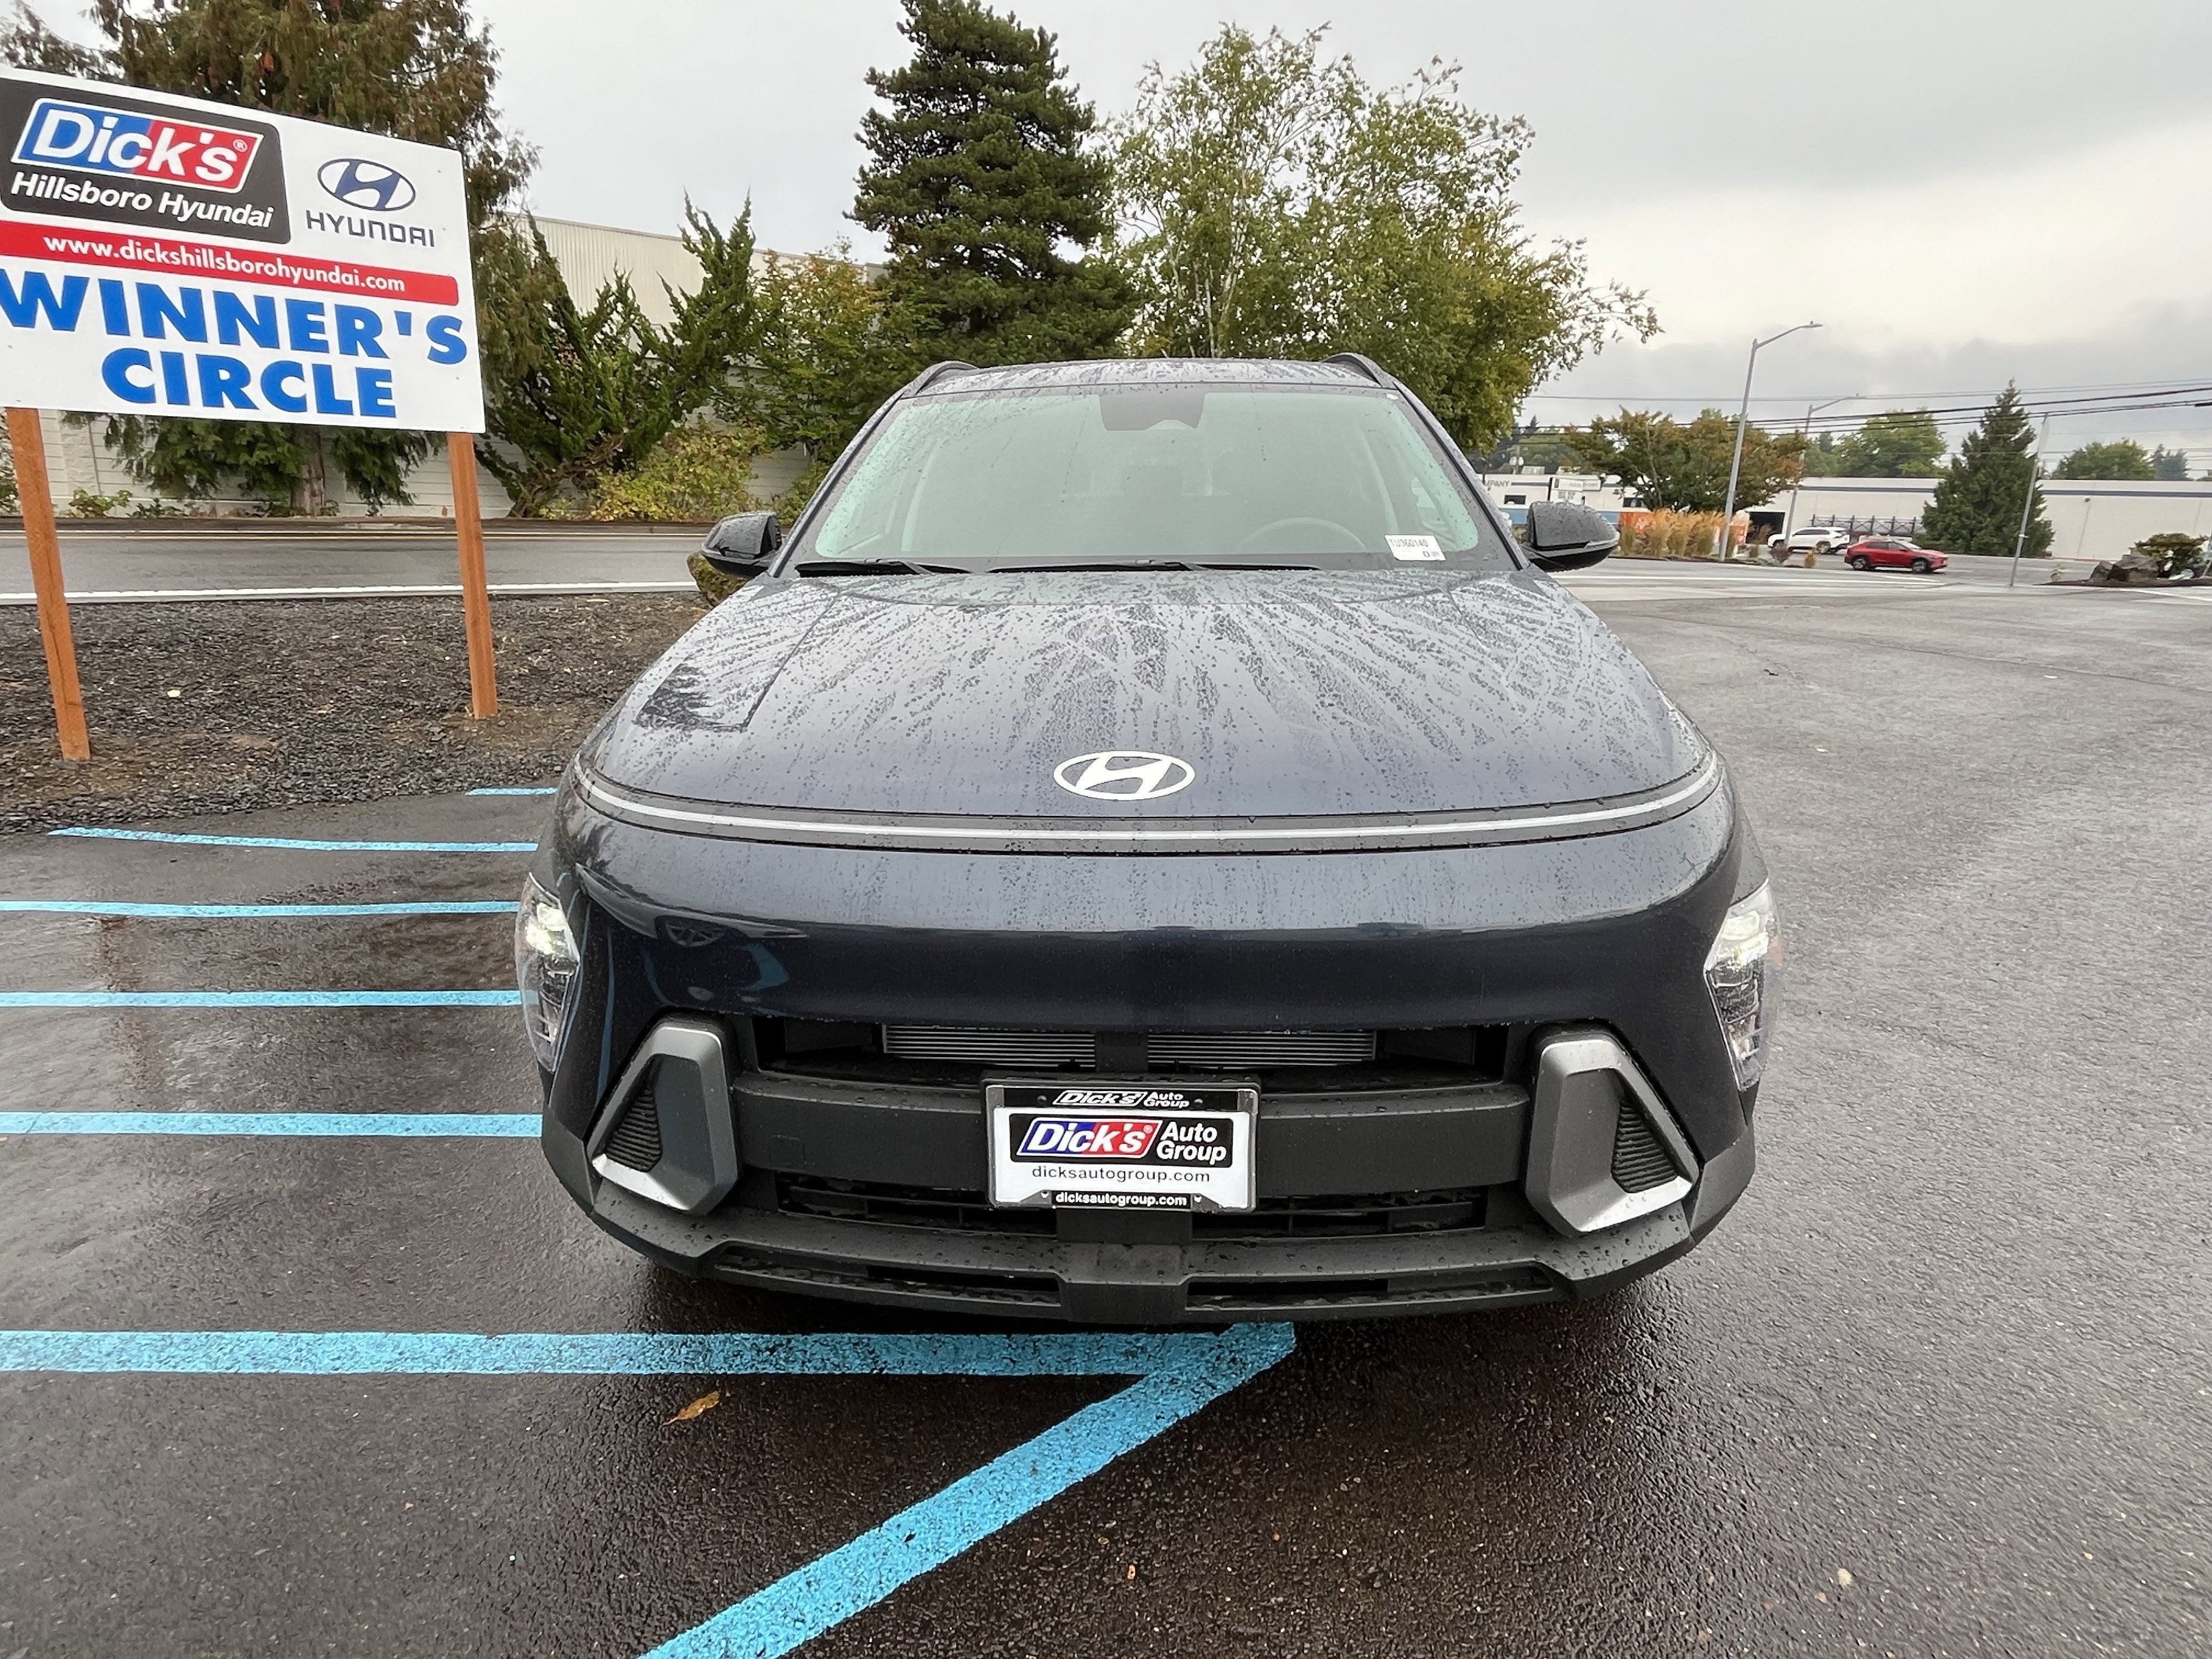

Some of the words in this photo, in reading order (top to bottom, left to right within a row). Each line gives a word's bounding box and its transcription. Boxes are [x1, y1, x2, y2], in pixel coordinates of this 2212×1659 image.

[11, 172, 153, 211] Hillsboro
[157, 191, 274, 228] Hyundai
[306, 210, 435, 247] HYUNDAI
[43, 236, 405, 292] www.dickshillsborohyundai.com
[0, 269, 468, 364] WINNER'S
[101, 348, 397, 417] CIRCLE
[1143, 1099, 1189, 1108] Group
[1149, 1092, 1184, 1101] Auto
[1160, 1121, 1217, 1142] Auto
[1156, 1141, 1227, 1165] Group
[1032, 1166, 1210, 1183] dicksautogroup.com
[1056, 1193, 1188, 1207] dicksautogroup.com
